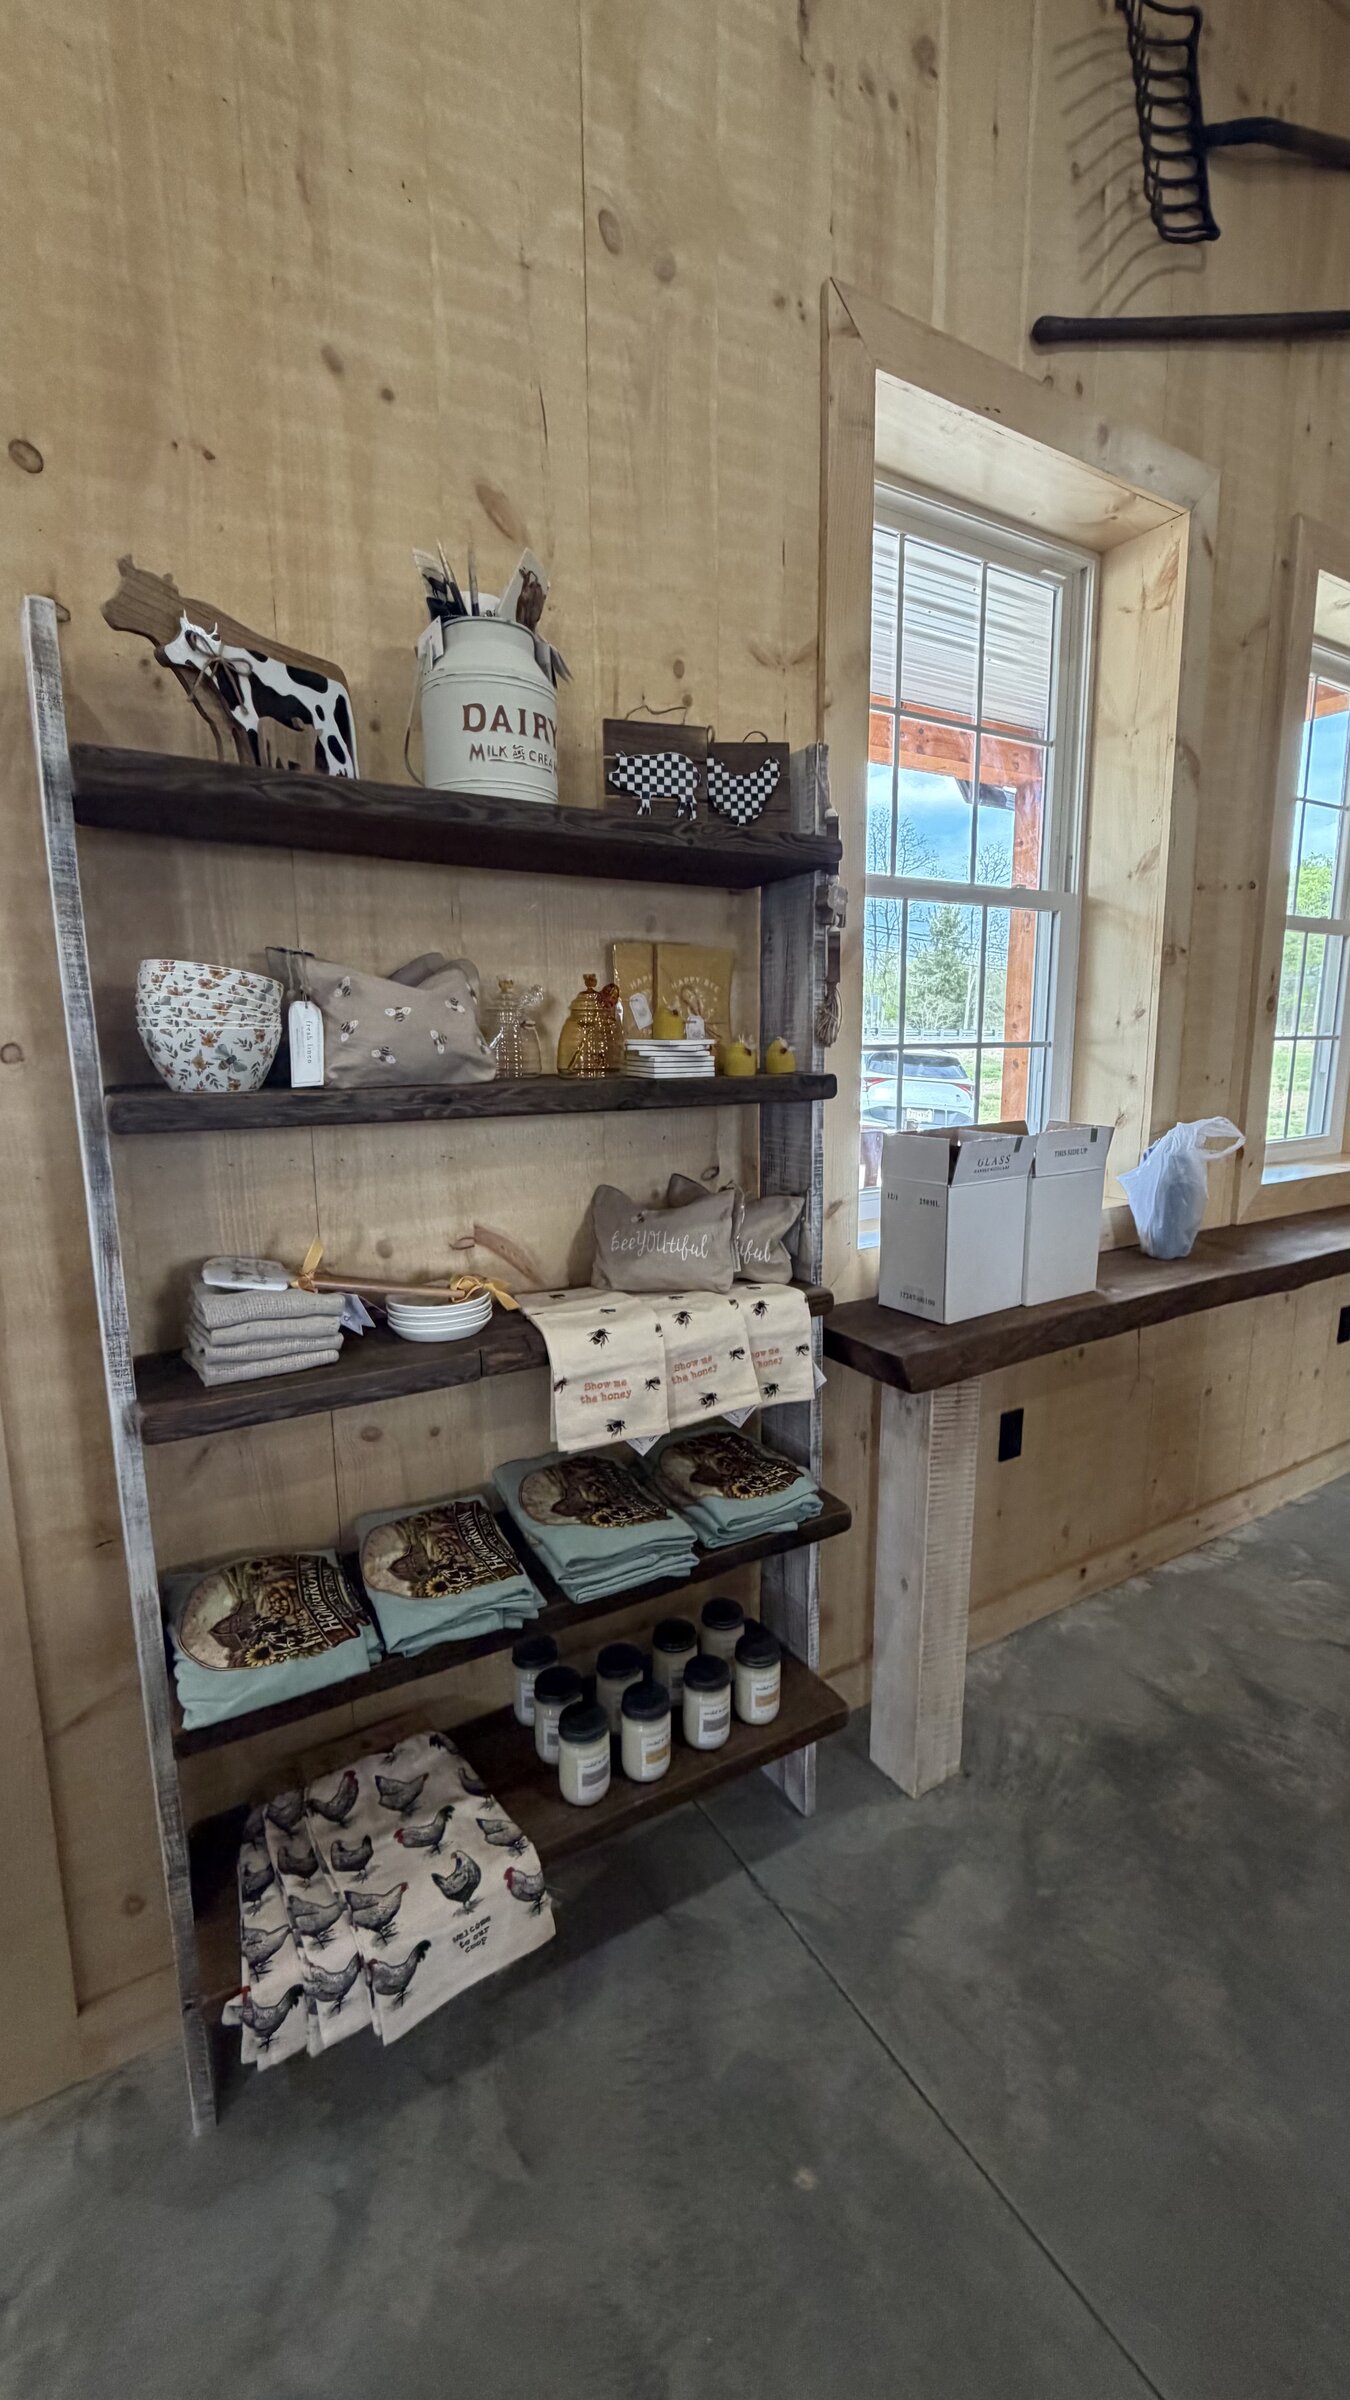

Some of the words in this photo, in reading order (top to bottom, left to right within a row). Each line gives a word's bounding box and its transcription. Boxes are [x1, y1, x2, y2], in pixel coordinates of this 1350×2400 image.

[462, 703, 557, 750] DAIRY
[469, 743, 508, 762] MILK
[977, 1154, 1011, 1167] GLASS
[674, 1360, 698, 1372] Show
[671, 1375, 689, 1385] the
[690, 1364, 717, 1378] honey
[584, 1381, 610, 1391] Show
[613, 1380, 627, 1388] me
[580, 1394, 598, 1404] the
[600, 1390, 631, 1401] honey
